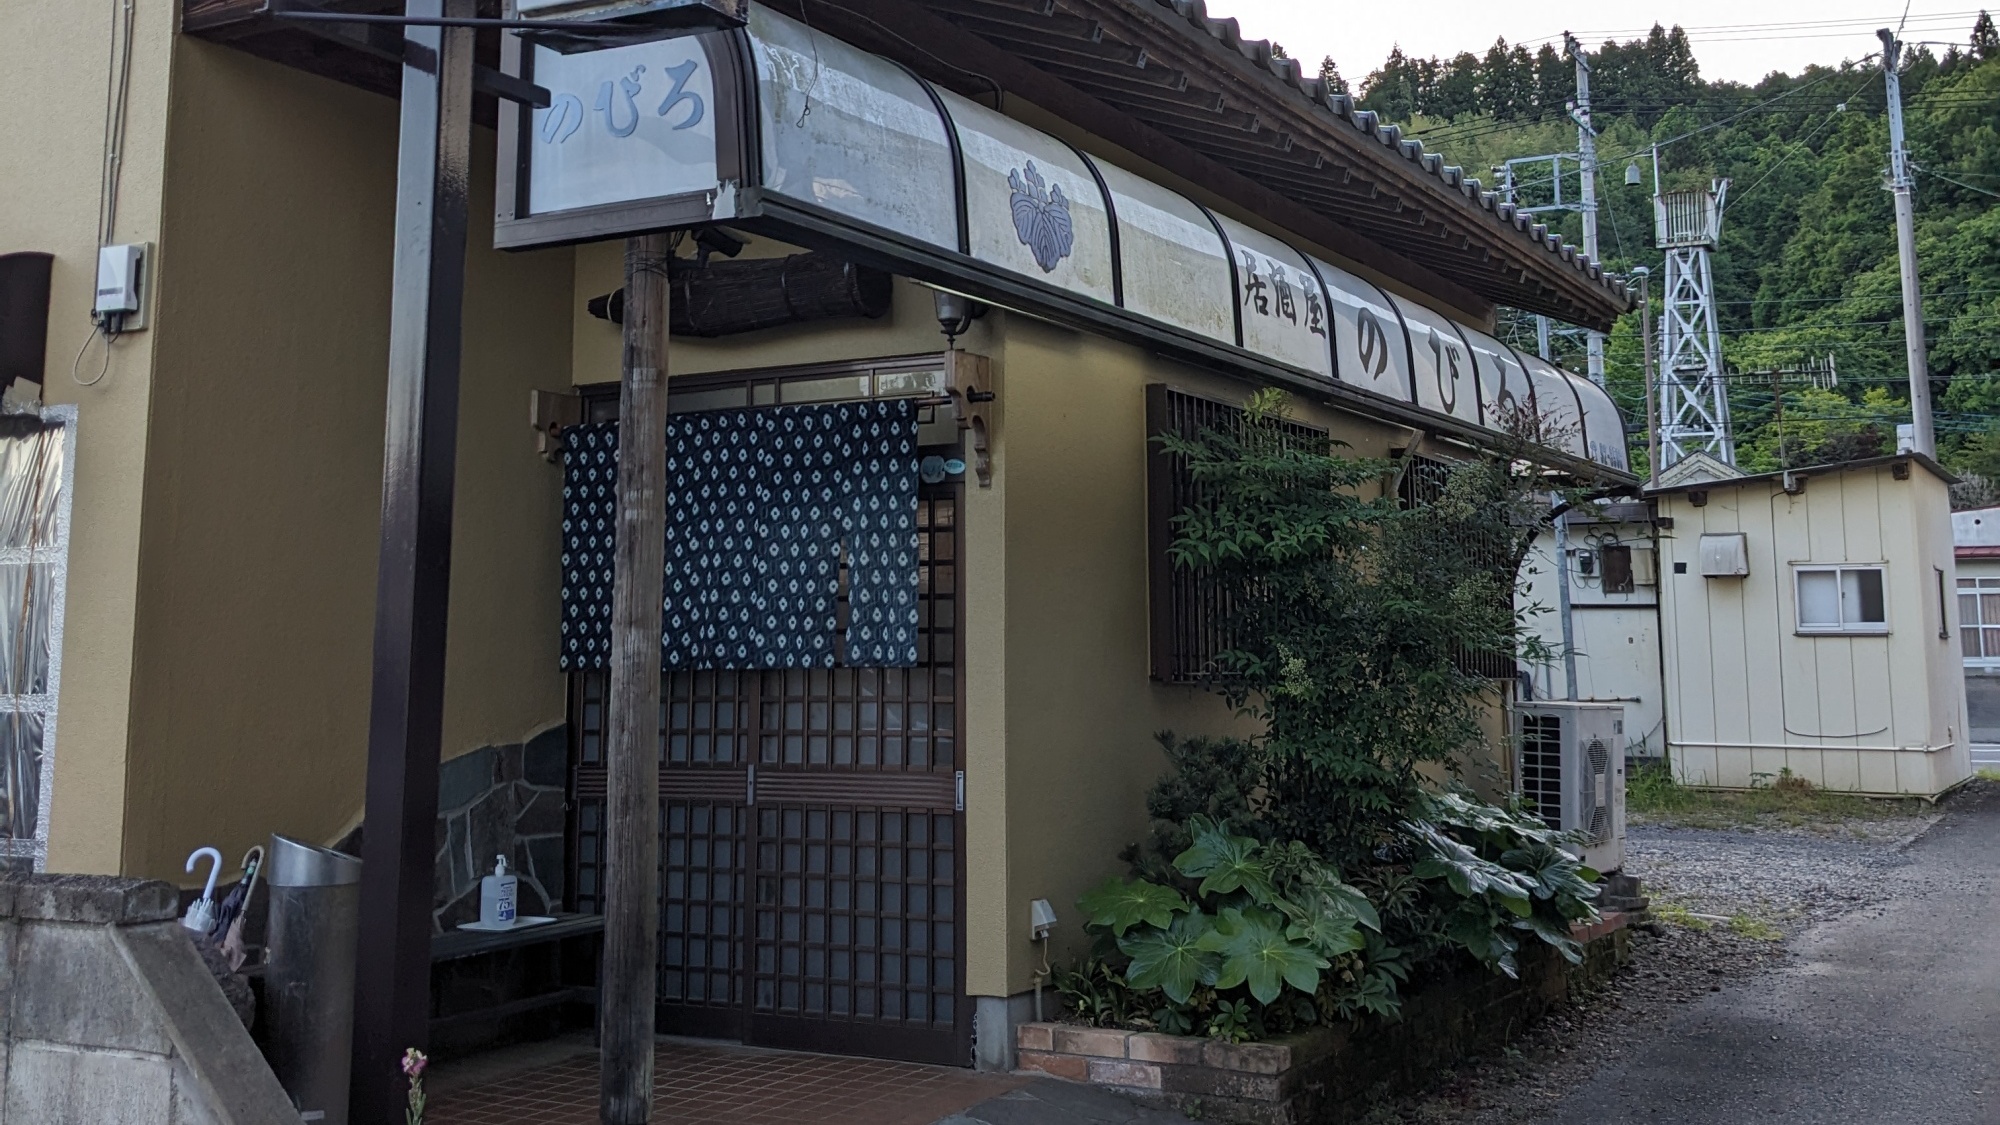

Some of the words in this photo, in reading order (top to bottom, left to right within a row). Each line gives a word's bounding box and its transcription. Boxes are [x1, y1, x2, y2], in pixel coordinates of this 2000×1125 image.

[540, 58, 704, 145] のびろ
[1241, 250, 1327, 340] 居酒屋
